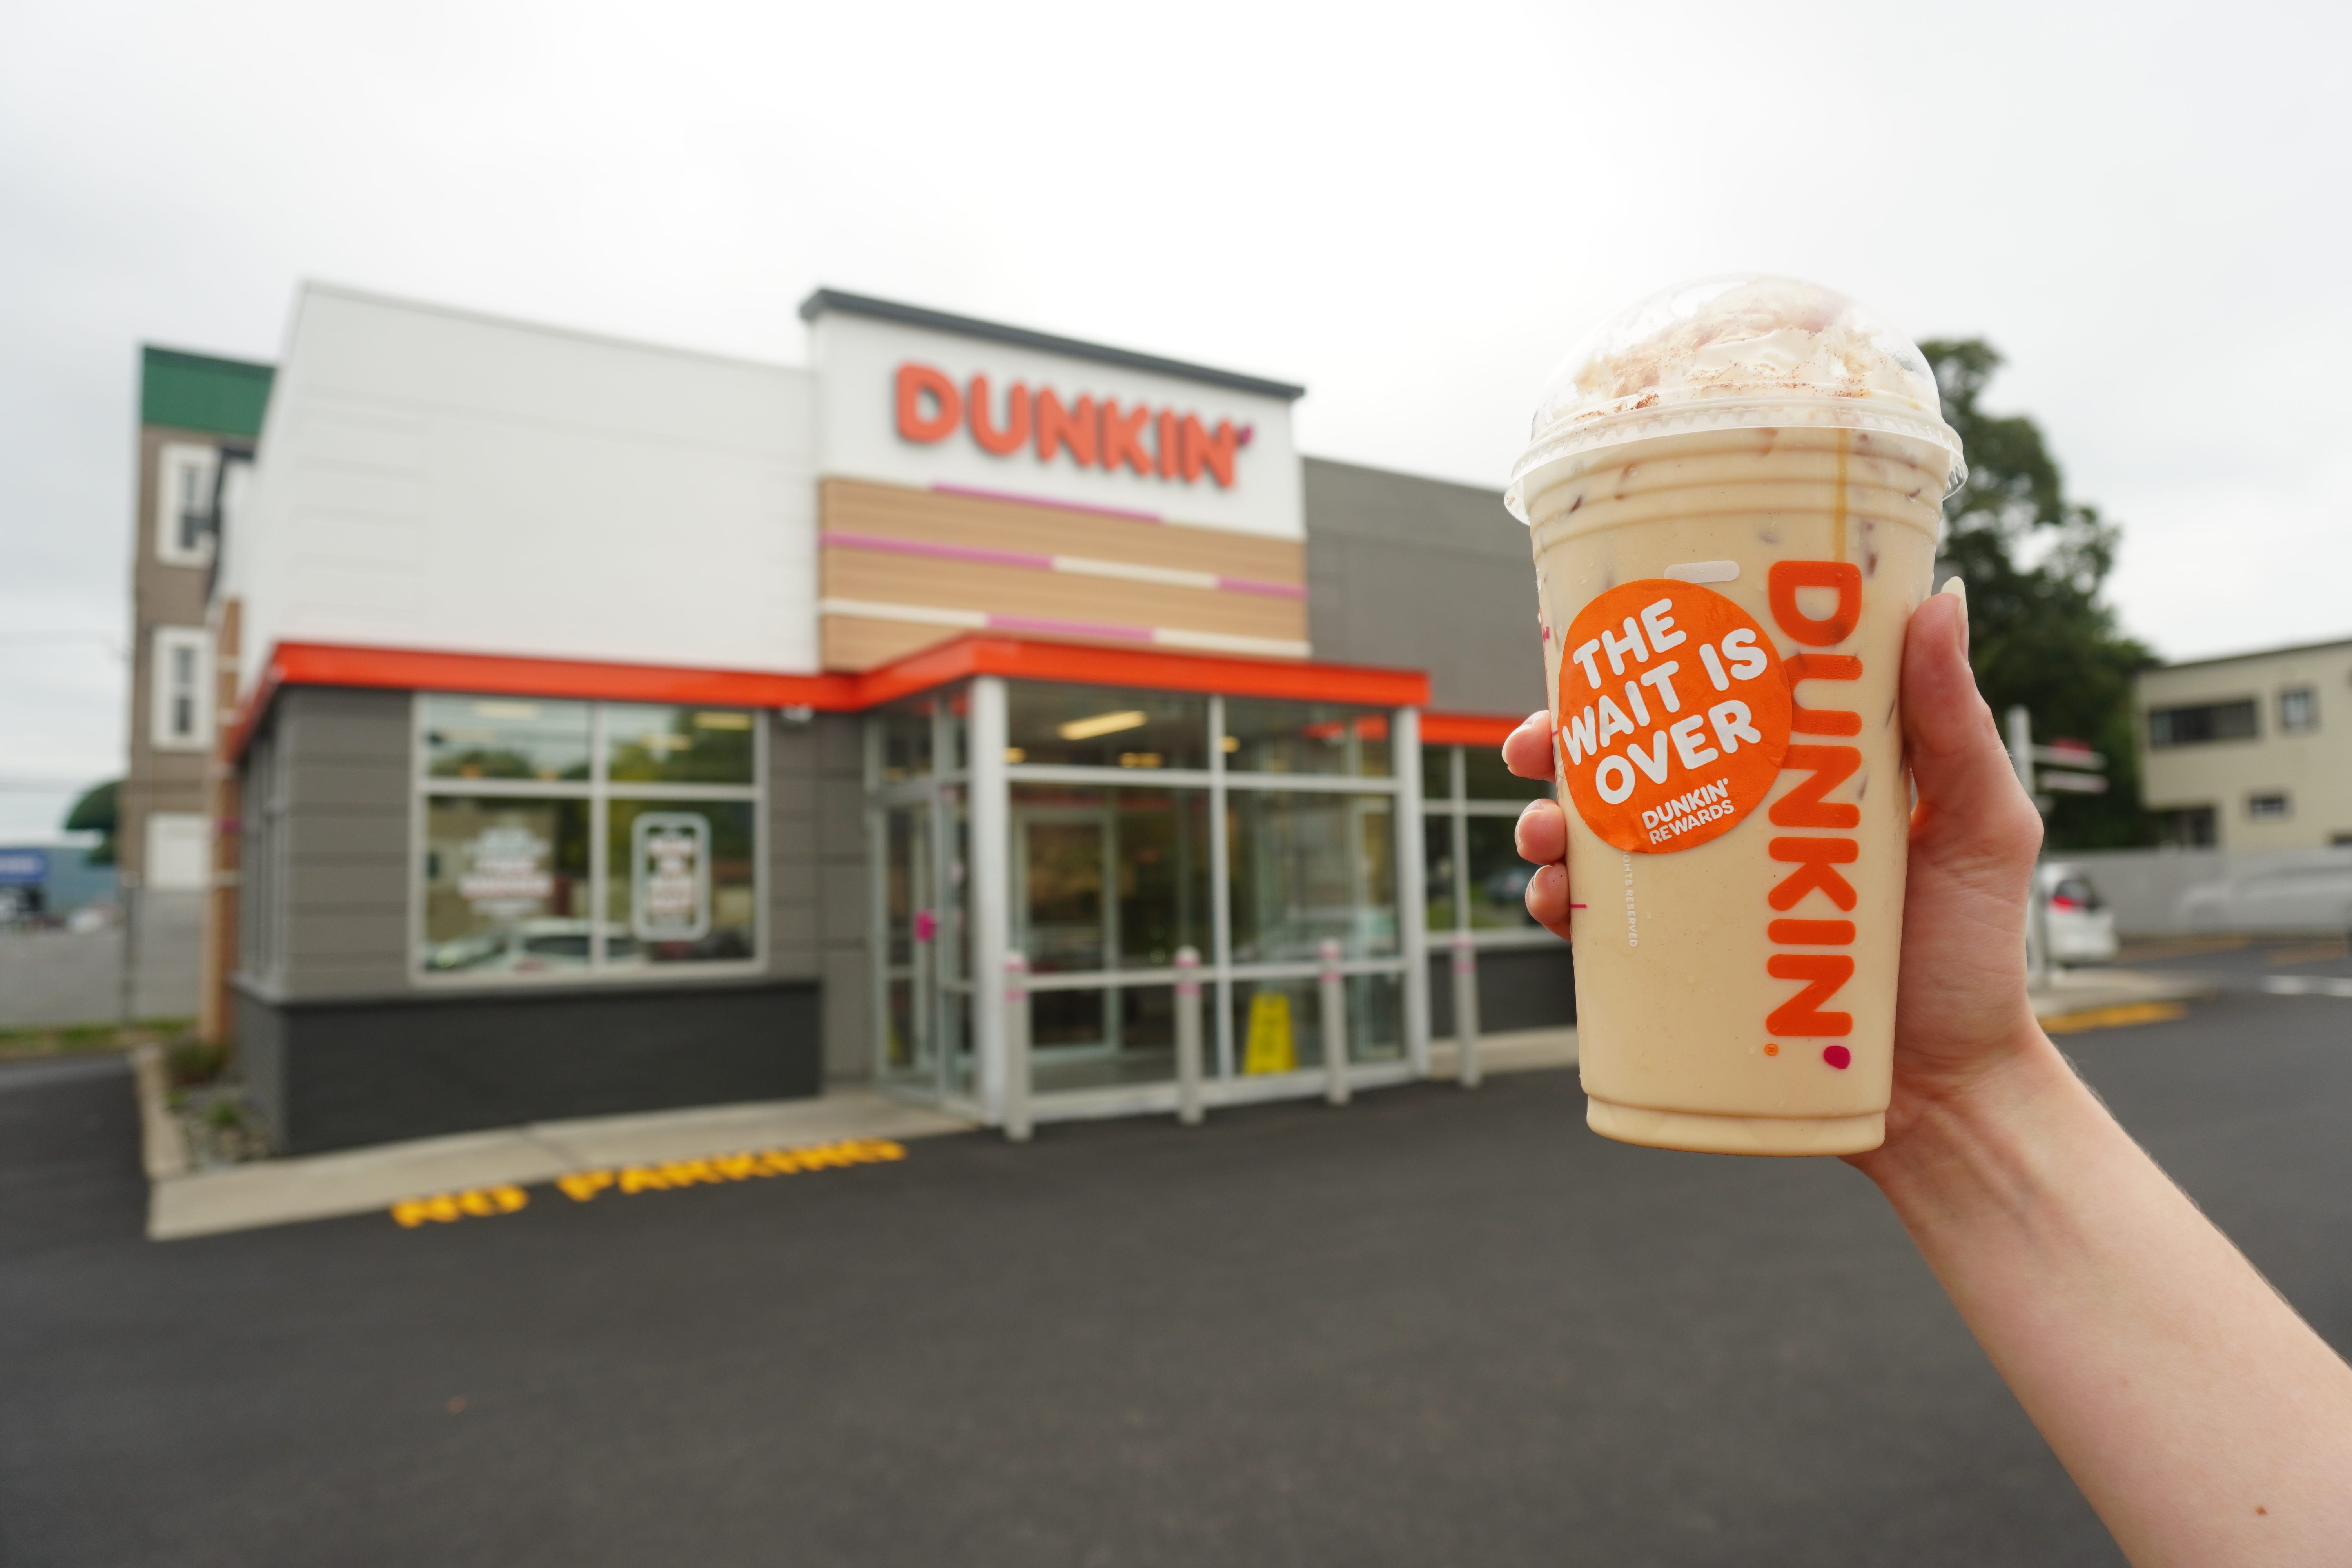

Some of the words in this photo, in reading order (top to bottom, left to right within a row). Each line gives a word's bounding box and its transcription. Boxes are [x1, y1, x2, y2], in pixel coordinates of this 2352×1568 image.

[895, 363, 1252, 488] DUNKIN'
[1573, 598, 1686, 689] THE
[1562, 661, 1680, 765] WAIT
[1699, 628, 1767, 691] IS
[1595, 700, 1761, 804] OVER
[1642, 777, 1728, 829] DUNKIN'
[1650, 800, 1734, 844] REWARDS
[1766, 560, 1862, 1069] DUNKIN'
[1623, 851, 1632, 886] IGHTS
[1626, 890, 1637, 947] RESERVED
